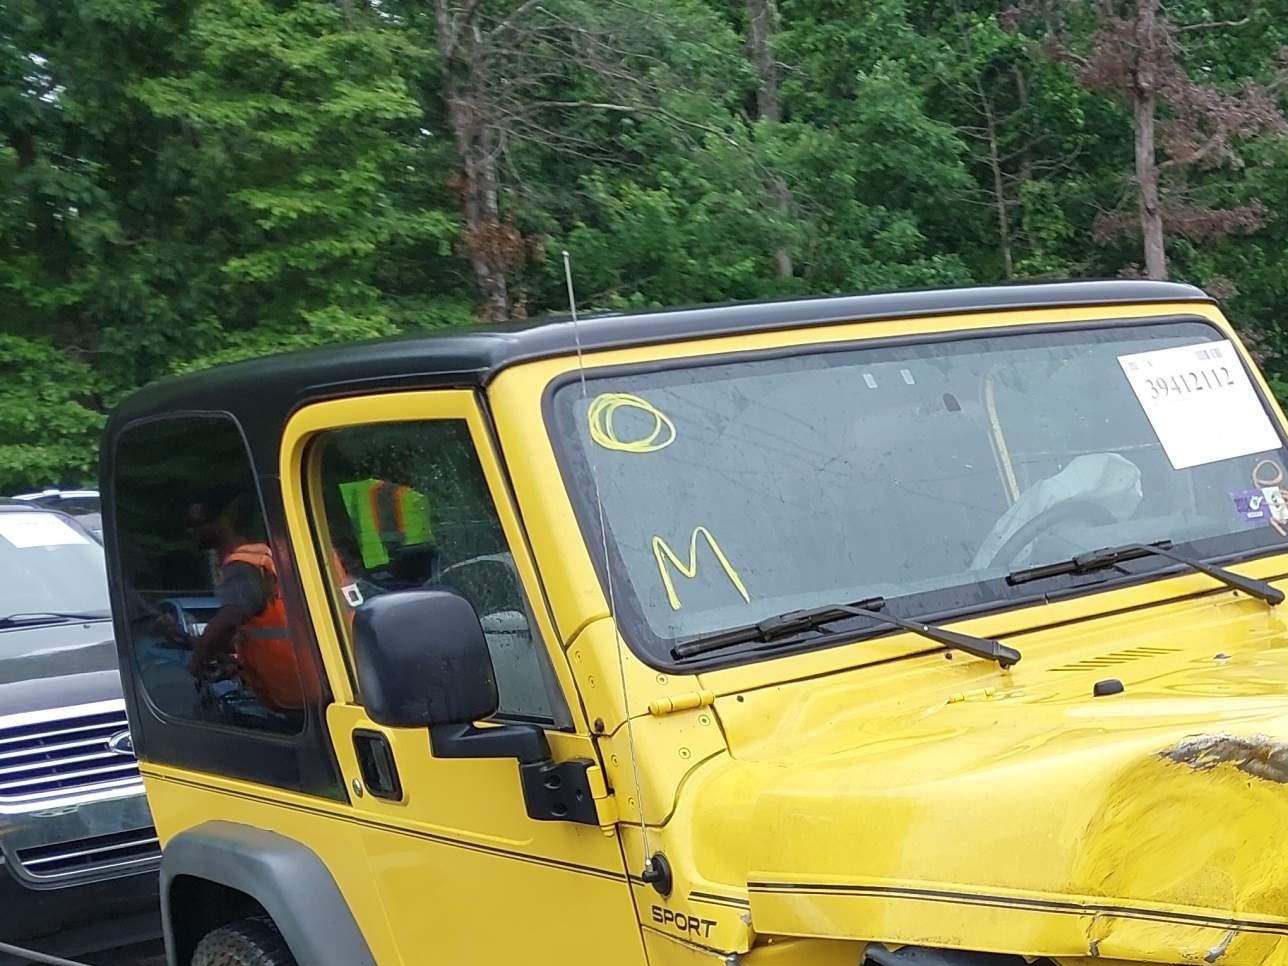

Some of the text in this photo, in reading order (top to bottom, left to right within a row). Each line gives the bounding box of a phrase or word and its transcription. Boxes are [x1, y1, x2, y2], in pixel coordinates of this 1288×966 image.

[1145, 366, 1235, 400] 39412112
[651, 525, 750, 611] M
[651, 904, 718, 939] SPORT
